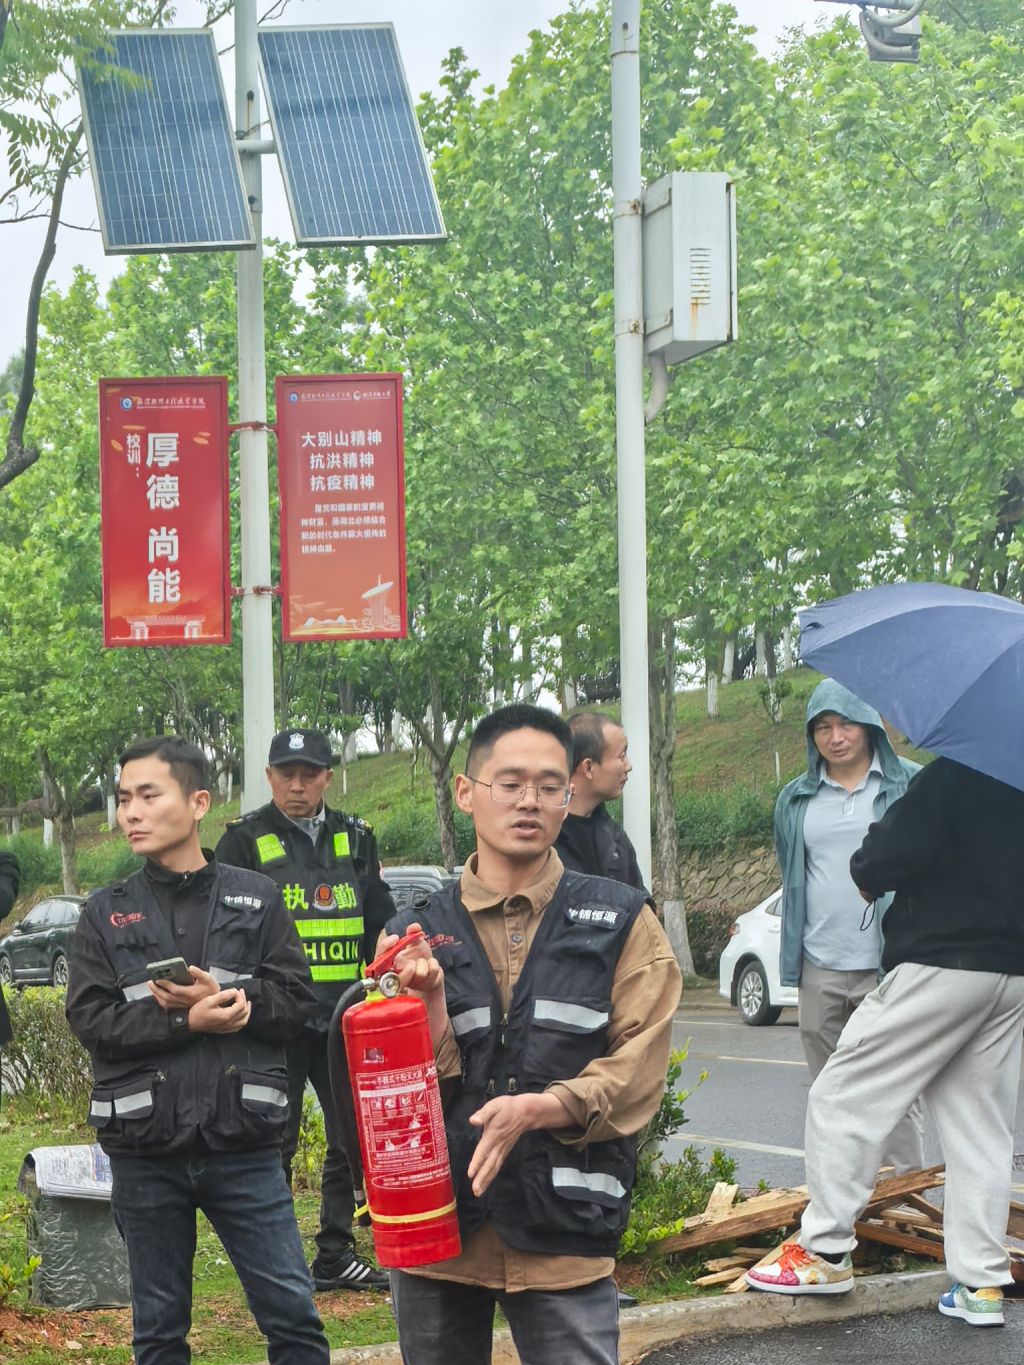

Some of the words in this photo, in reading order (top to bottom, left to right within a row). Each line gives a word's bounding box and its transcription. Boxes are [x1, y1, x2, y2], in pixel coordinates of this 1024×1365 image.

[301, 430, 383, 448] 大别山精神
[310, 452, 375, 469] 抗洪精神
[310, 474, 375, 491] 抗疫精神
[282, 883, 309, 910] 执
[333, 882, 357, 909] 勤
